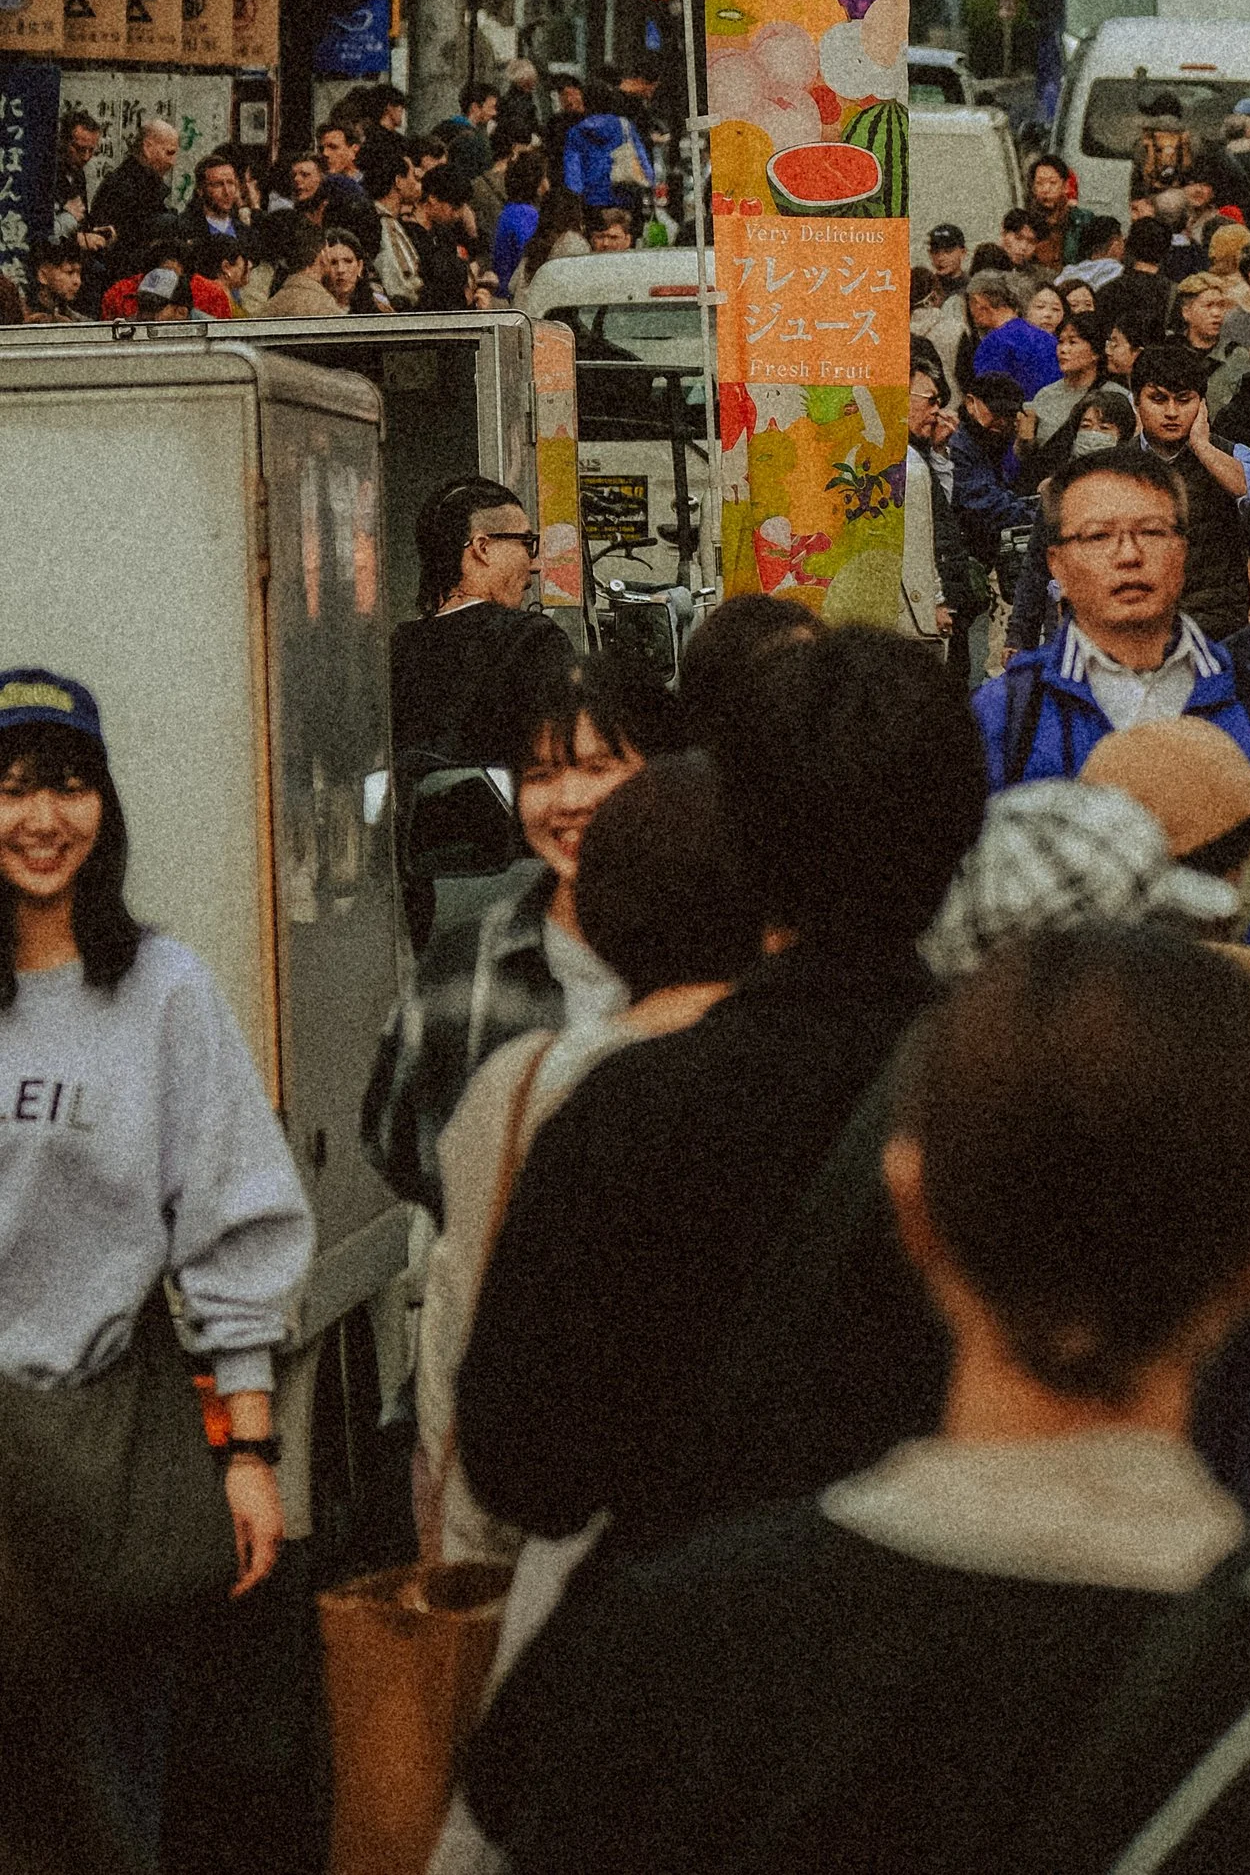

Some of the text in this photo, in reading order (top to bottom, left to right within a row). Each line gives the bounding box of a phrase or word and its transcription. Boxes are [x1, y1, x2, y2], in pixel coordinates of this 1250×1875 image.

[745, 224, 885, 244] Very Delicious
[733, 255, 897, 296] フレッシュ
[744, 302, 881, 345] ジュース
[750, 359, 871, 380] Fresh Fruit
[0, 1078, 96, 1132] EIL
